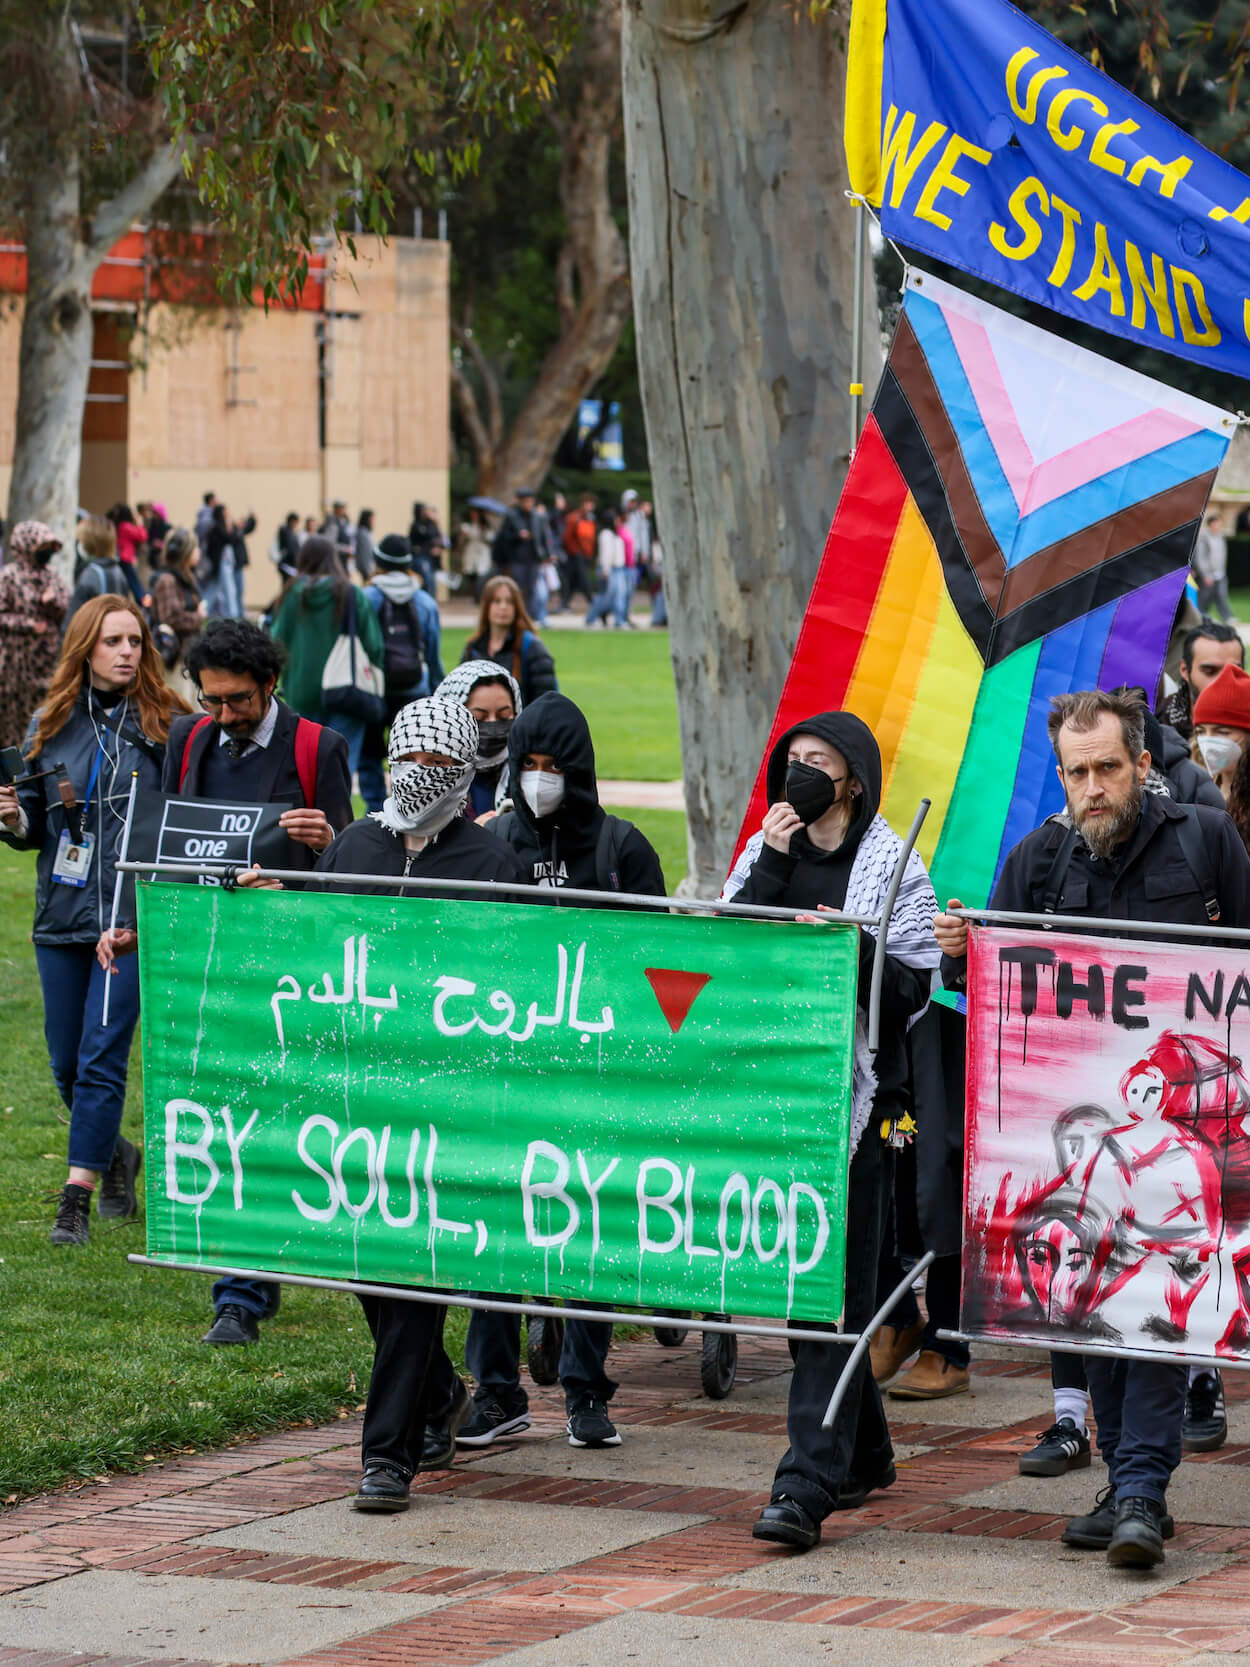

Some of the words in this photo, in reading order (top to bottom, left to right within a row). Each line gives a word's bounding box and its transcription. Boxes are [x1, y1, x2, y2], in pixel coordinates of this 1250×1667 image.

[882, 103, 993, 232] WE
[988, 175, 1223, 348] STAND
[184, 838, 228, 857] one
[220, 813, 251, 832] no
[270, 933, 399, 1038] بالدم
[433, 941, 615, 1042] بالروح
[999, 946, 1151, 1029] THE
[164, 1099, 260, 1211] BY
[291, 1113, 489, 1257] SOUL,
[521, 1140, 620, 1254] BY
[635, 1156, 831, 1275] BLOOD
